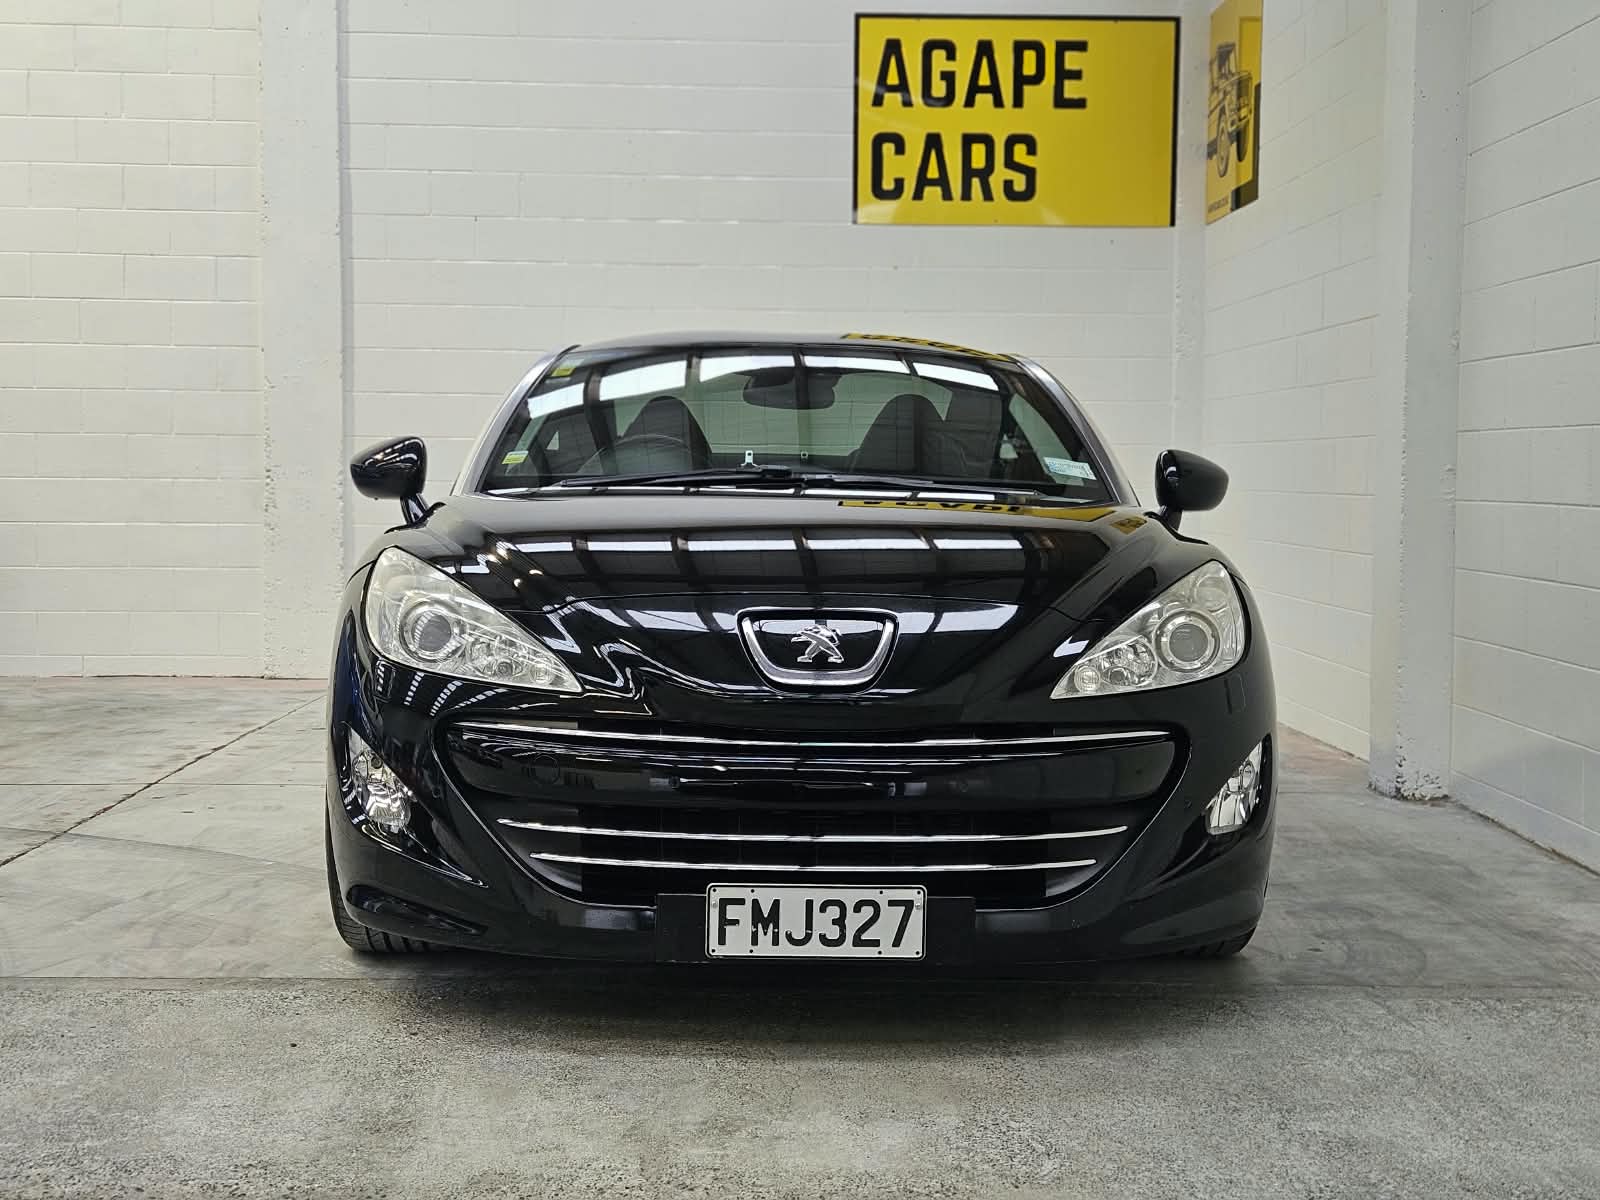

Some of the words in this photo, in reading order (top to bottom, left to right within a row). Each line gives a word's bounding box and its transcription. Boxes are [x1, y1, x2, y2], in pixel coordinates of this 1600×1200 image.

[871, 38, 1089, 110] AGAPE
[871, 132, 1038, 202] CARS
[717, 898, 915, 948] FMJ327
